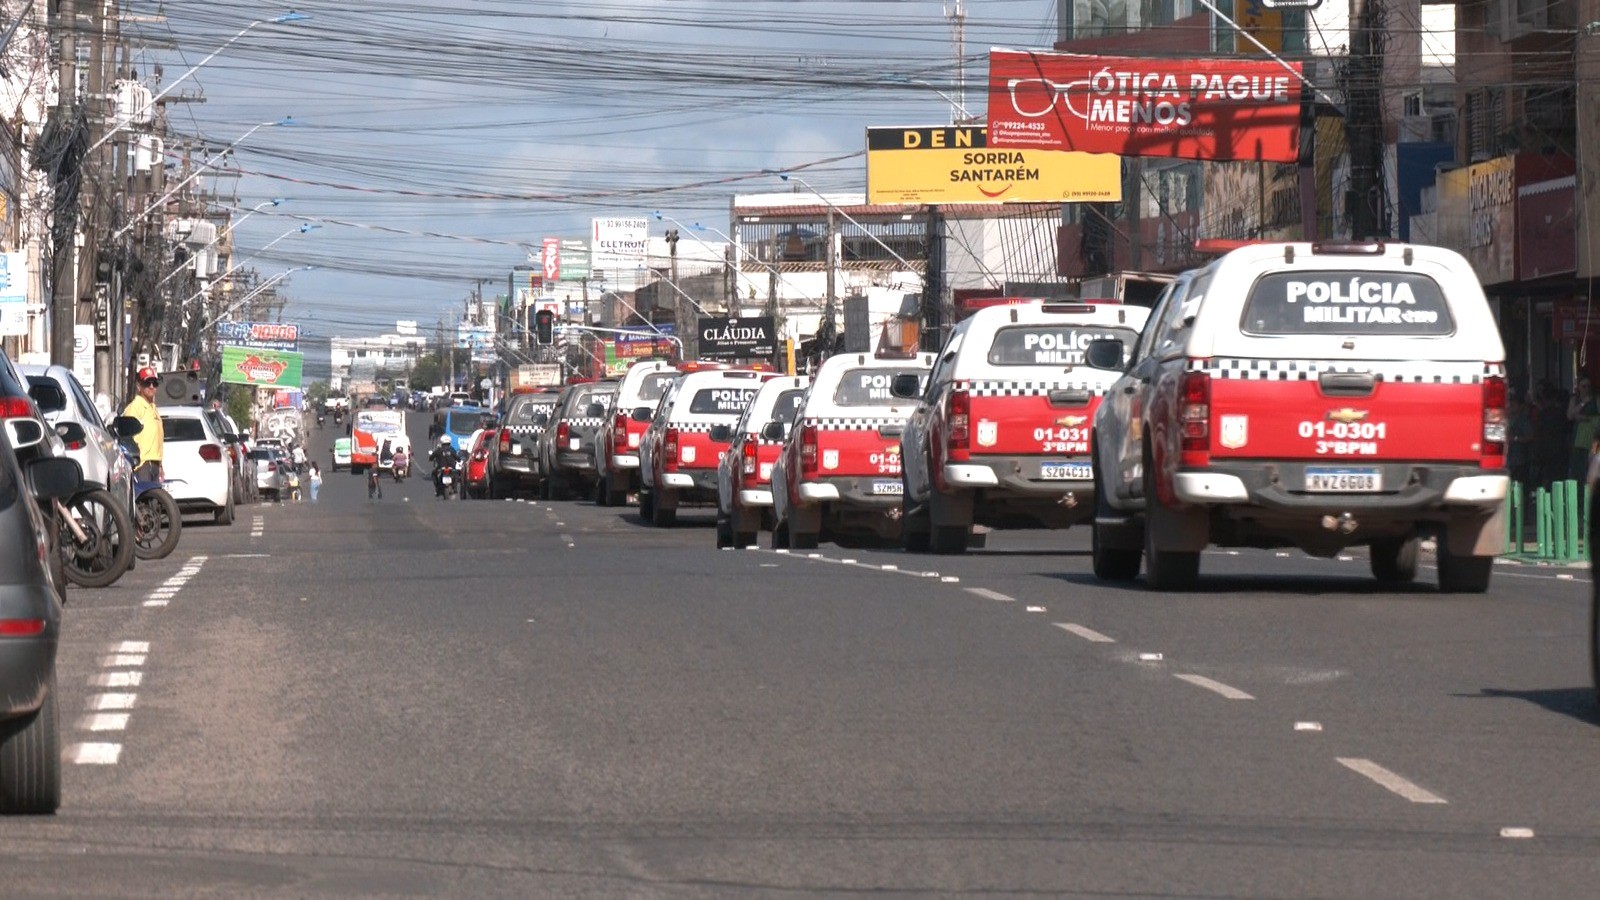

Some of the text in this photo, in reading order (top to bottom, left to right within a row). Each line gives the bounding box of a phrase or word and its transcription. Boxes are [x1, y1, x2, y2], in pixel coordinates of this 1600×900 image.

[1091, 66, 1290, 102] ÓTICA PAGUE
[1090, 99, 1192, 126] MENOS
[1090, 123, 1113, 132] Menor
[963, 152, 1025, 165] SORRIA
[950, 165, 1039, 182] SANTARÉM
[545, 243, 557, 279] SKY
[1286, 277, 1416, 304] POLÍCIA
[1303, 306, 1402, 323] MILITAR
[703, 325, 766, 341] CLÁUDIA
[1298, 421, 1386, 439] 01-0301
